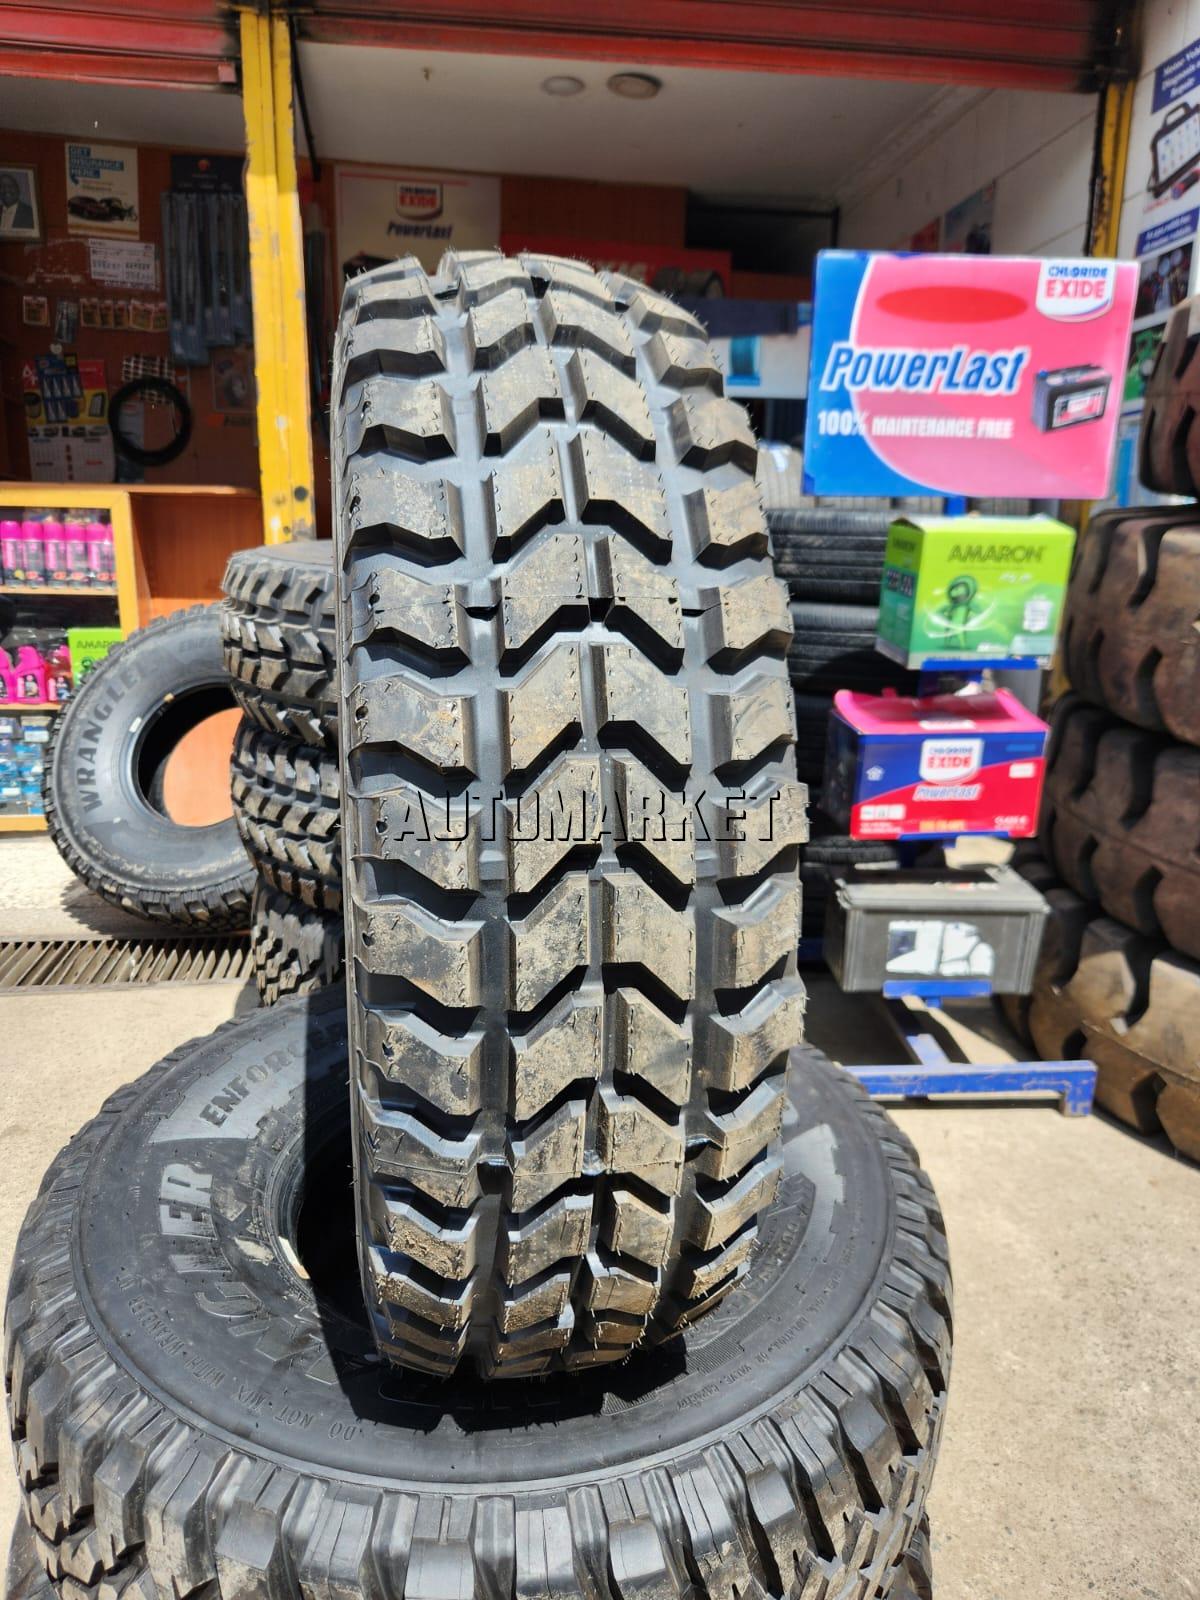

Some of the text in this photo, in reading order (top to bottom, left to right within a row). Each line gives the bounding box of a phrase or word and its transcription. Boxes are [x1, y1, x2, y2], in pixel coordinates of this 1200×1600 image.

[1048, 266, 1108, 277] CHLORIDE
[1045, 279, 1105, 299] EXIDE
[822, 347, 1026, 392] PowerLast
[818, 410, 1013, 439] 100% MAINTENANCE FREE
[948, 544, 1044, 563] AMARON
[274, 1406, 314, 1428] NOT
